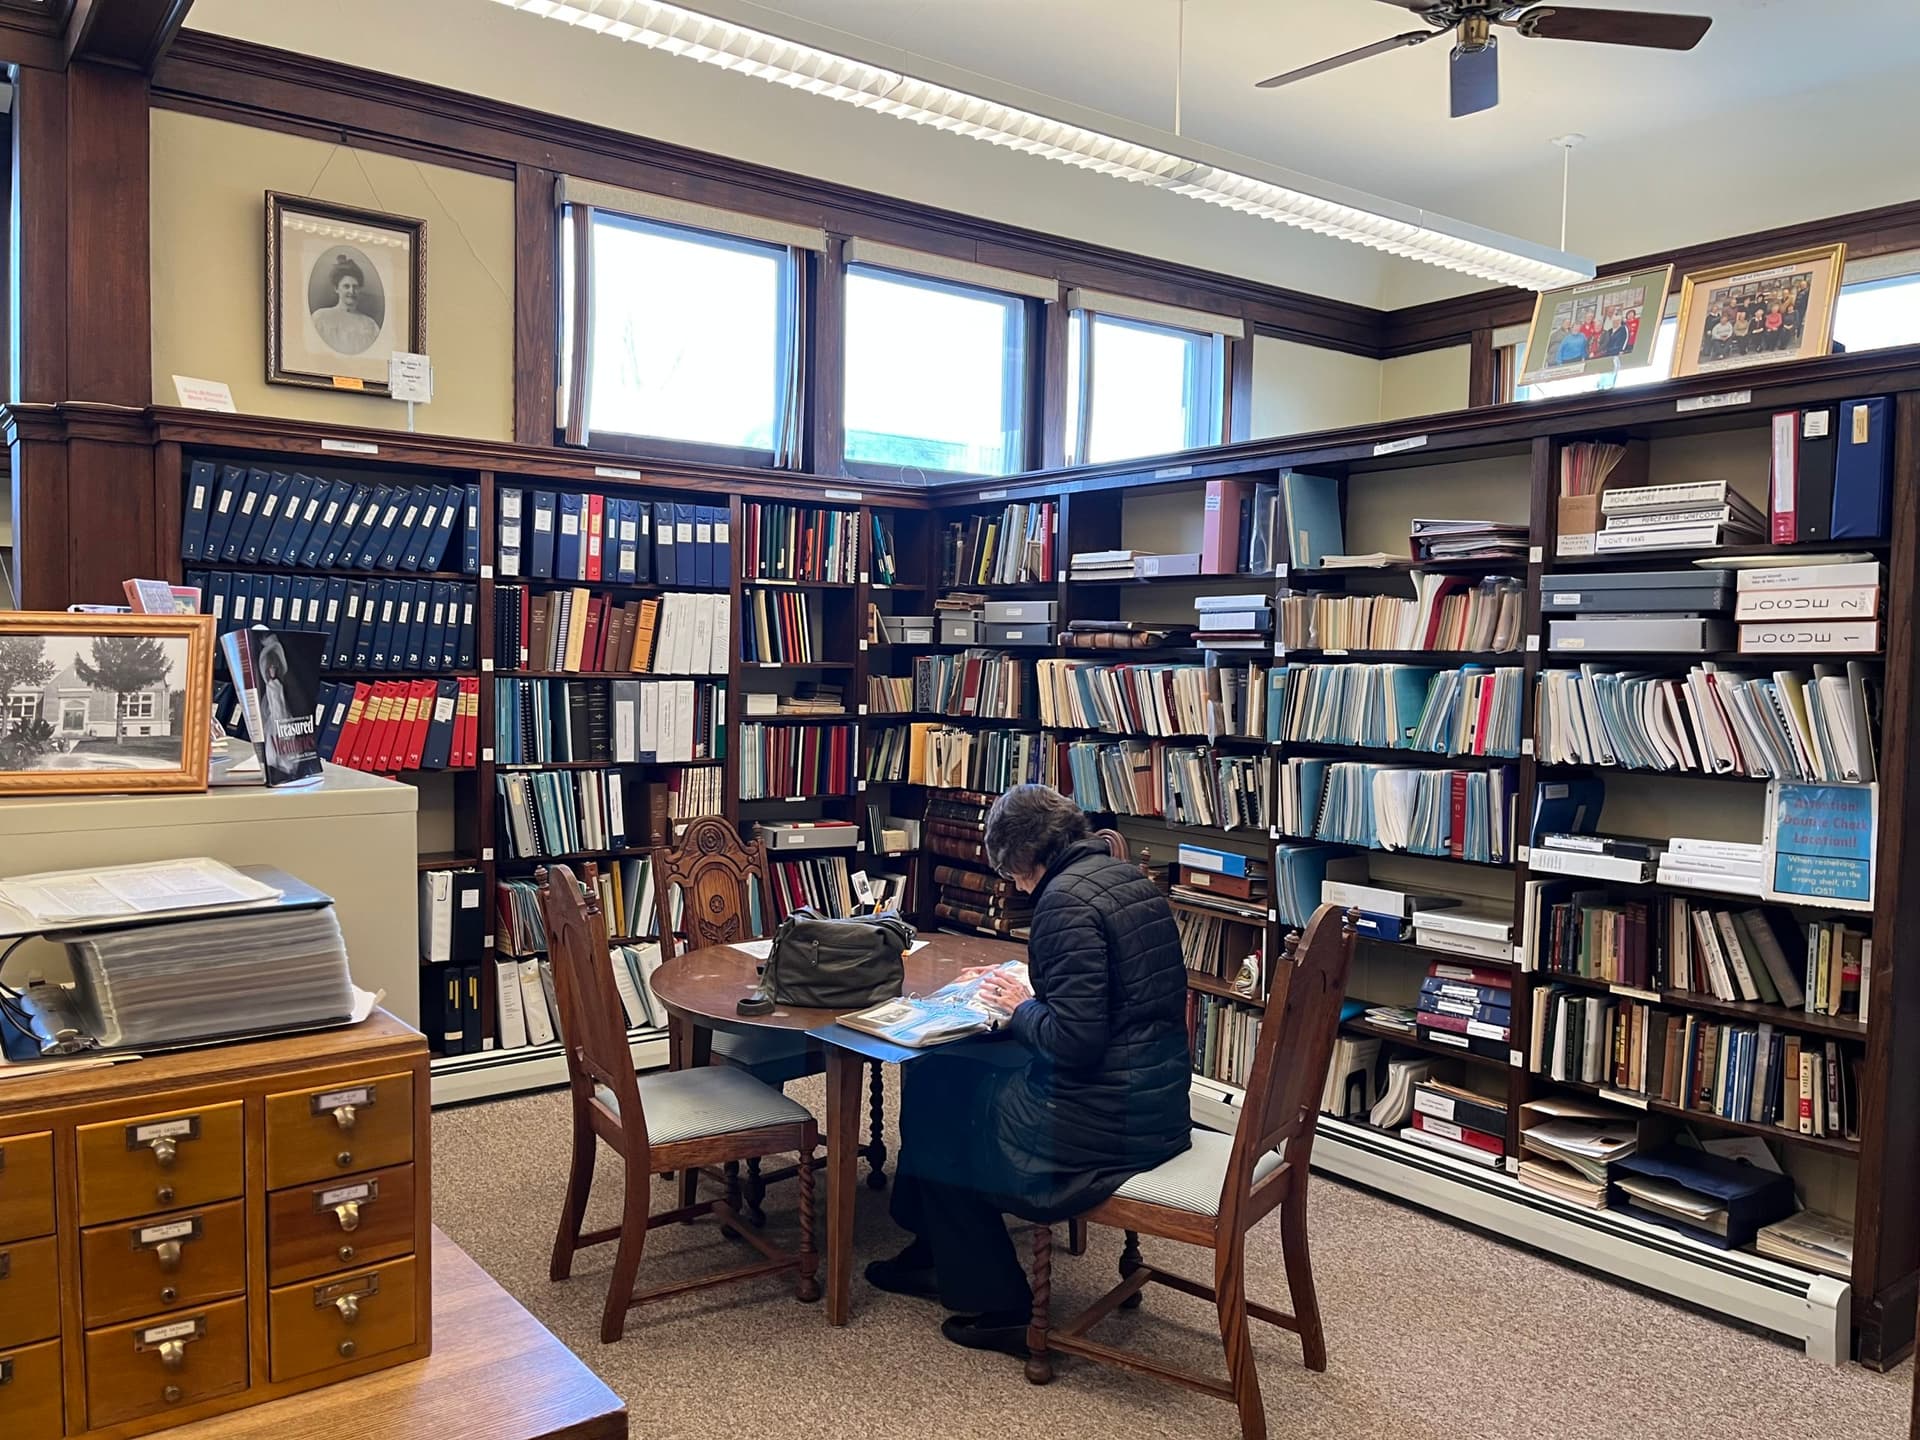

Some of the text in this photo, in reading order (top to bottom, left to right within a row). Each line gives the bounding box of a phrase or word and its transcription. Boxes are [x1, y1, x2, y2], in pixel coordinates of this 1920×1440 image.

[1741, 598, 1858, 611] LOGUE 2
[1744, 632, 1832, 644] LOGUE
[274, 714, 314, 738] Treasured
[1833, 817, 1867, 831] Check
[1793, 832, 1857, 848] Location!!
[1787, 855, 1813, 865] When
[1796, 868, 1811, 876] you
[1812, 869, 1827, 877] put
[1848, 871, 1861, 879] the
[1791, 876, 1857, 888] wrong shelf, IT'S
[1810, 886, 1836, 896] LOST!
